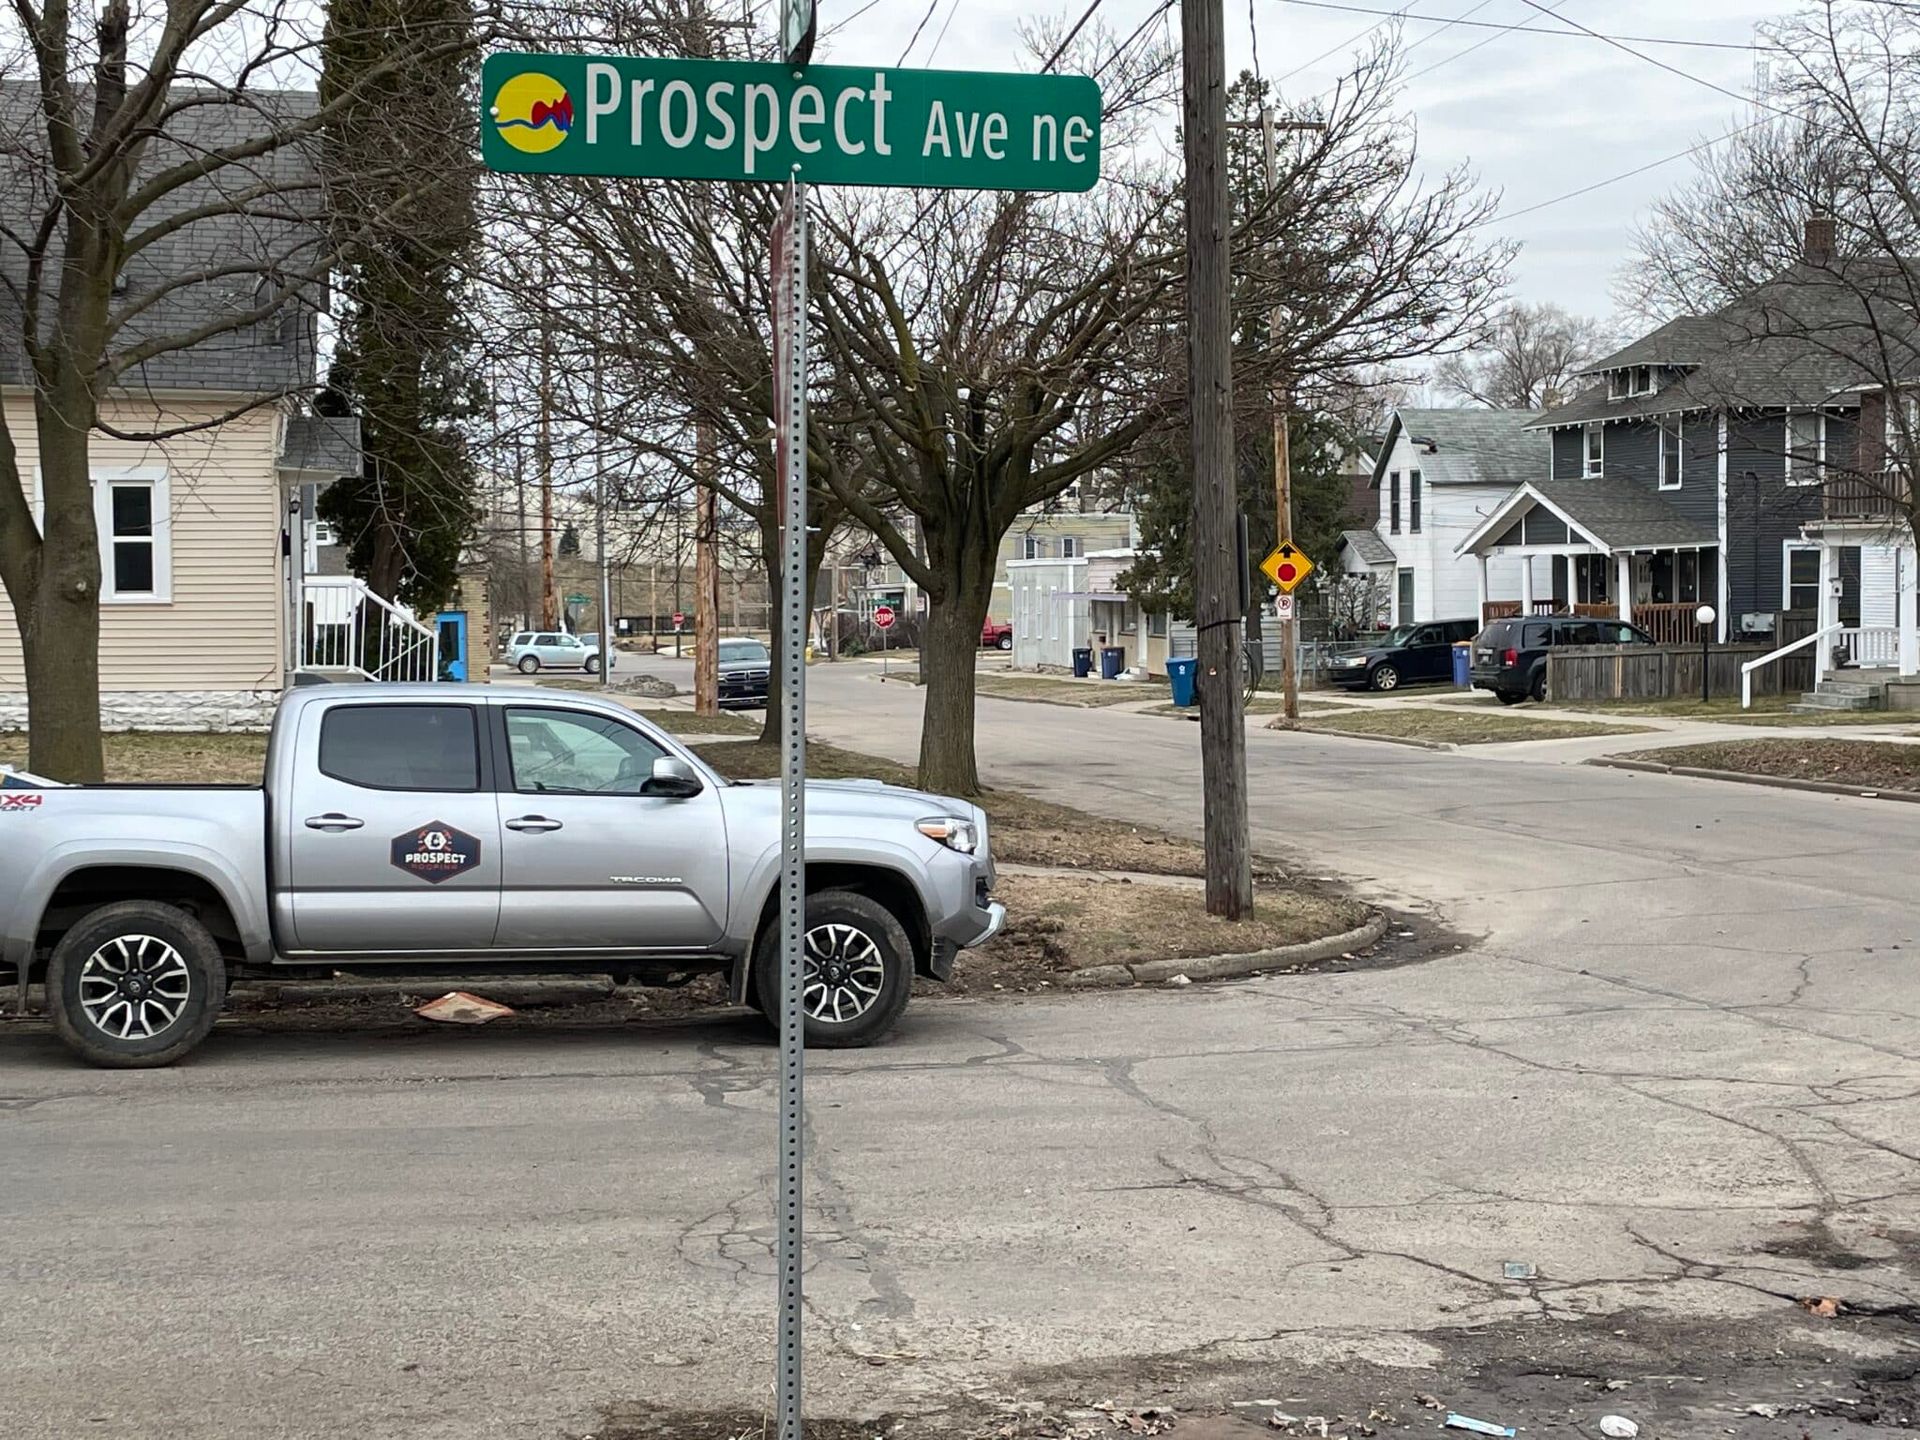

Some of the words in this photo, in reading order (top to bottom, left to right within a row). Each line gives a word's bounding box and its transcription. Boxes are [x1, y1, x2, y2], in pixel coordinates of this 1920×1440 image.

[586, 63, 892, 174] Prospect
[922, 101, 1008, 160] Ave
[1033, 114, 1088, 163] ne
[405, 852, 466, 864] PROSPECT
